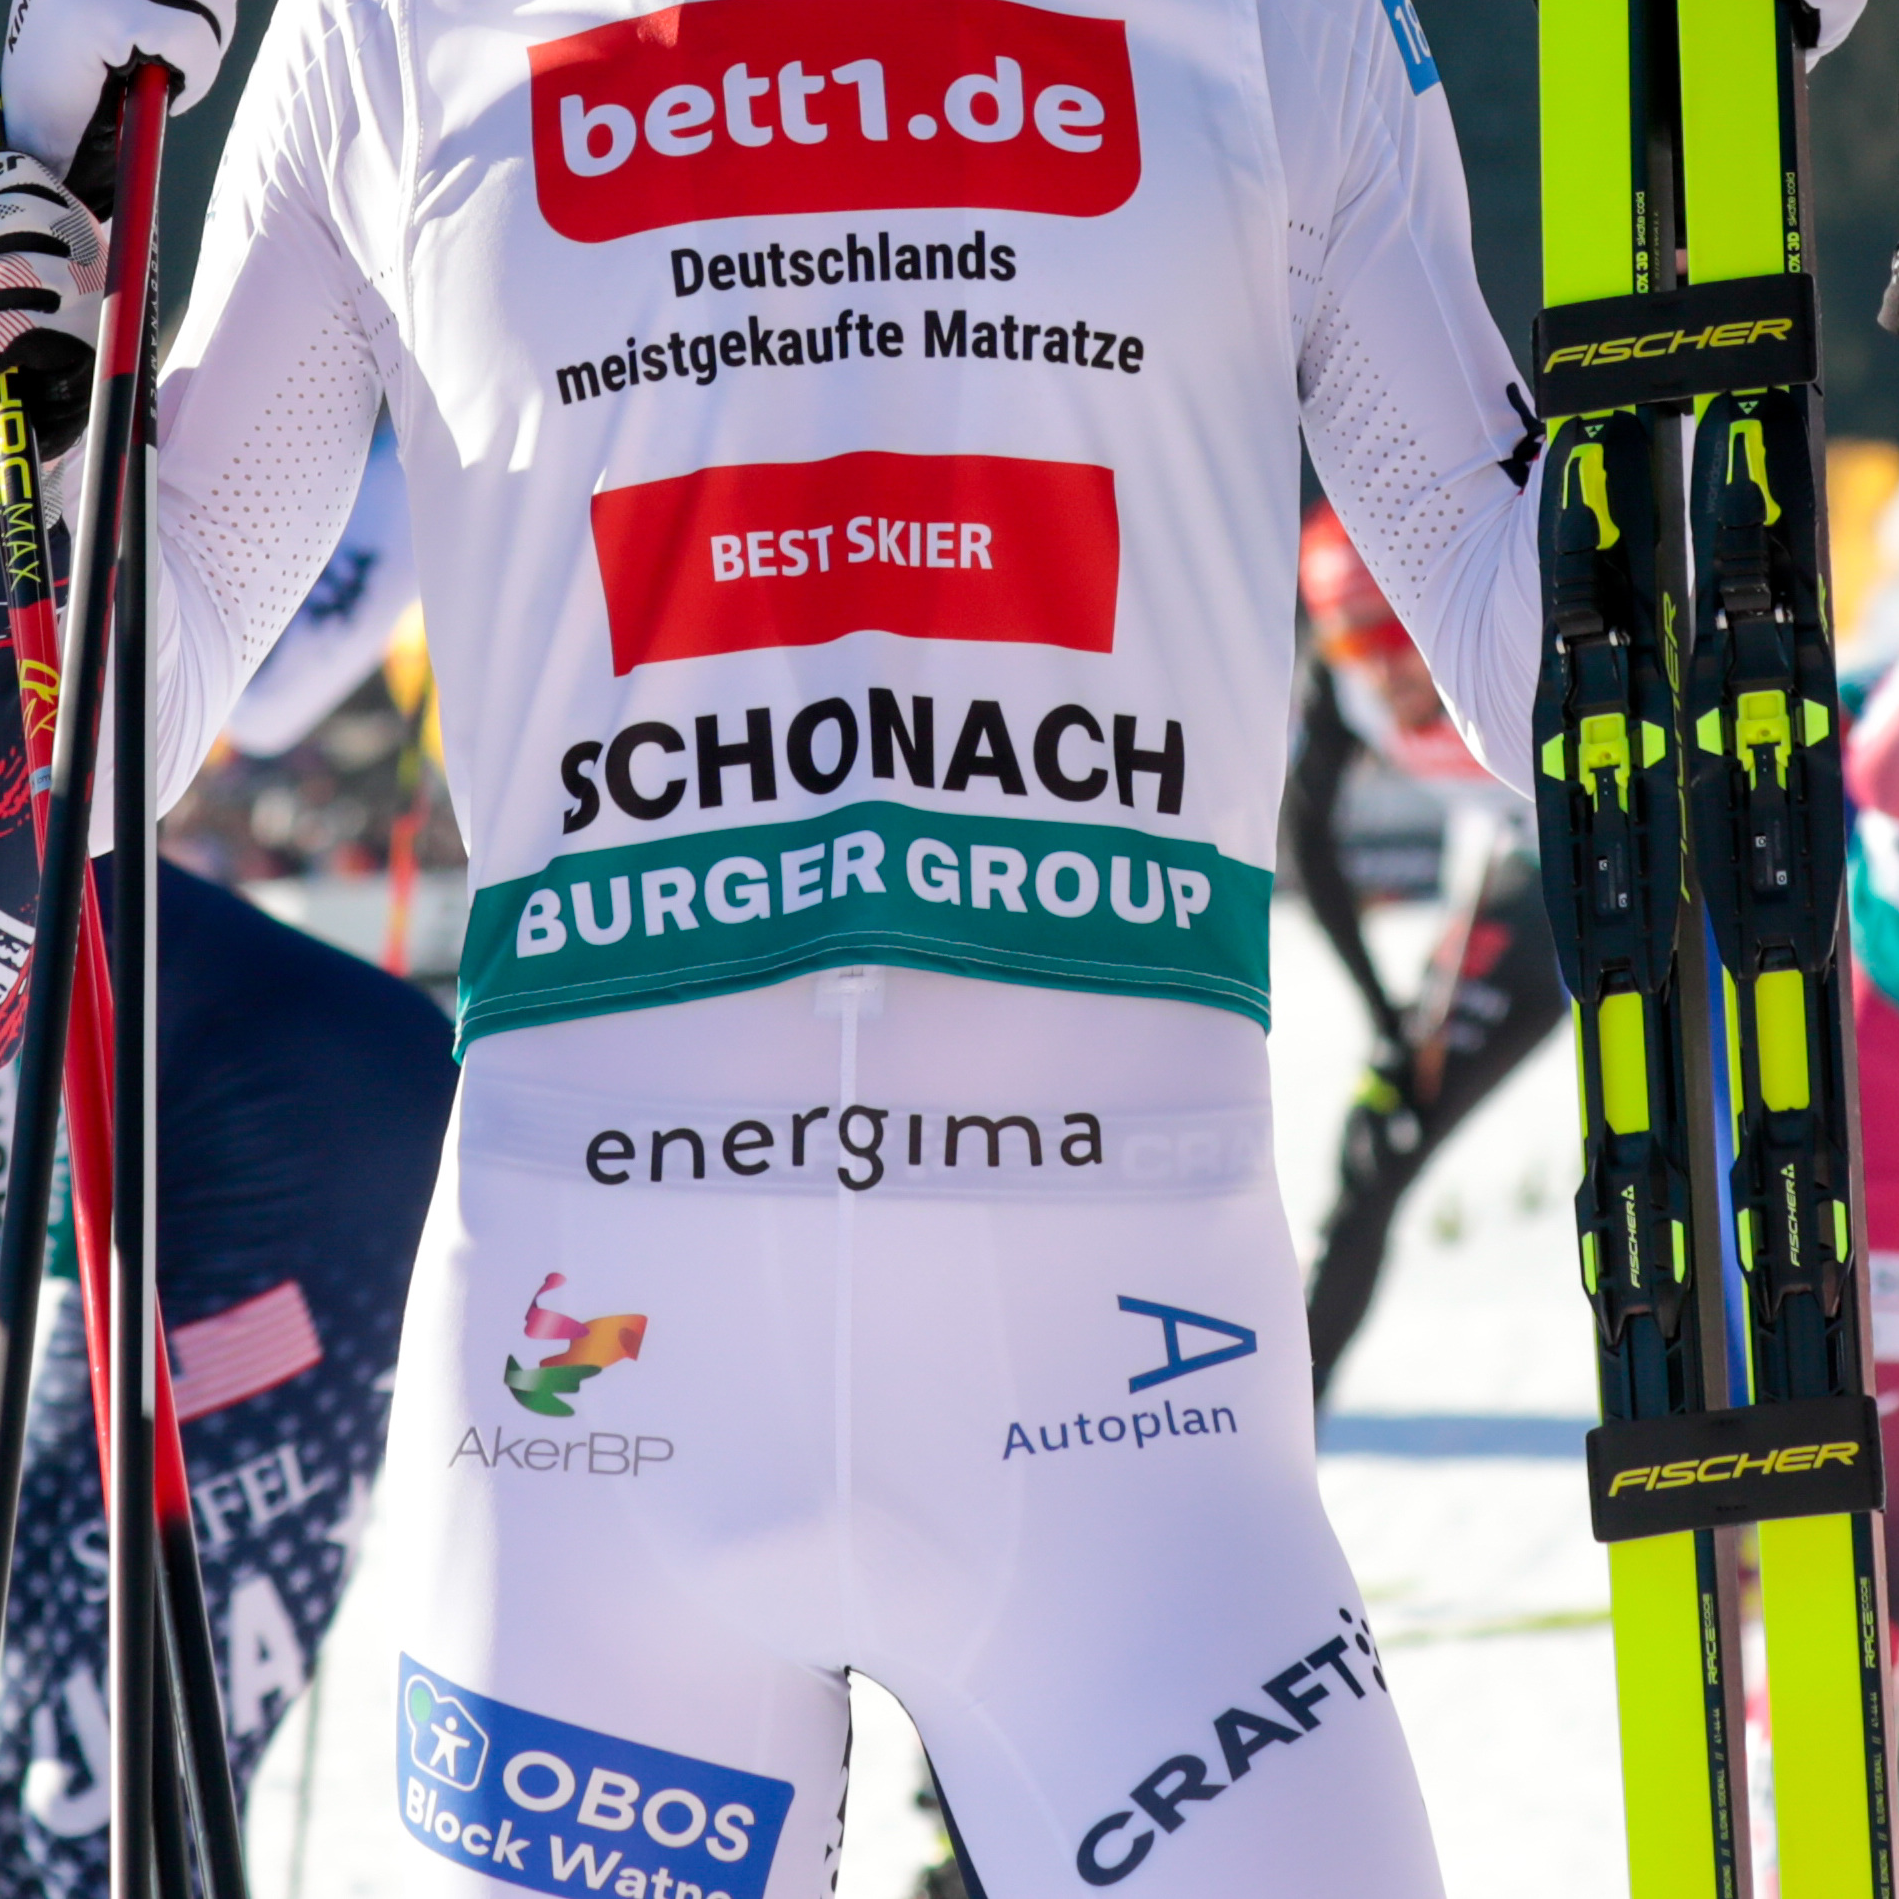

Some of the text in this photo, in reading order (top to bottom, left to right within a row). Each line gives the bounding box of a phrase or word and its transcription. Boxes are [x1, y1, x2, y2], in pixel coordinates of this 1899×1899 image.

[557, 55, 1106, 179] bett1.de
[669, 228, 1017, 300] Deutschlands
[555, 308, 1147, 407] meistgekaufte Matratze
[1543, 316, 1795, 376] FISCHER
[710, 515, 995, 583] BEST SKIER
[560, 687, 1186, 836] SCHONACH
[515, 829, 1212, 959] BURGER GROUP
[585, 1105, 1105, 1193] energima
[1626, 1201, 1641, 1289] FISCHER
[1788, 1178, 1802, 1268] FISCHER
[1002, 1400, 1240, 1462] Autoplan
[1608, 1439, 1858, 1497] FISCHER
[21, 1574, 305, 1838] UA
[1075, 1631, 1371, 1887] CRAFT
[403, 1778, 527, 1867] Block
[501, 1747, 758, 1864] OBOS
